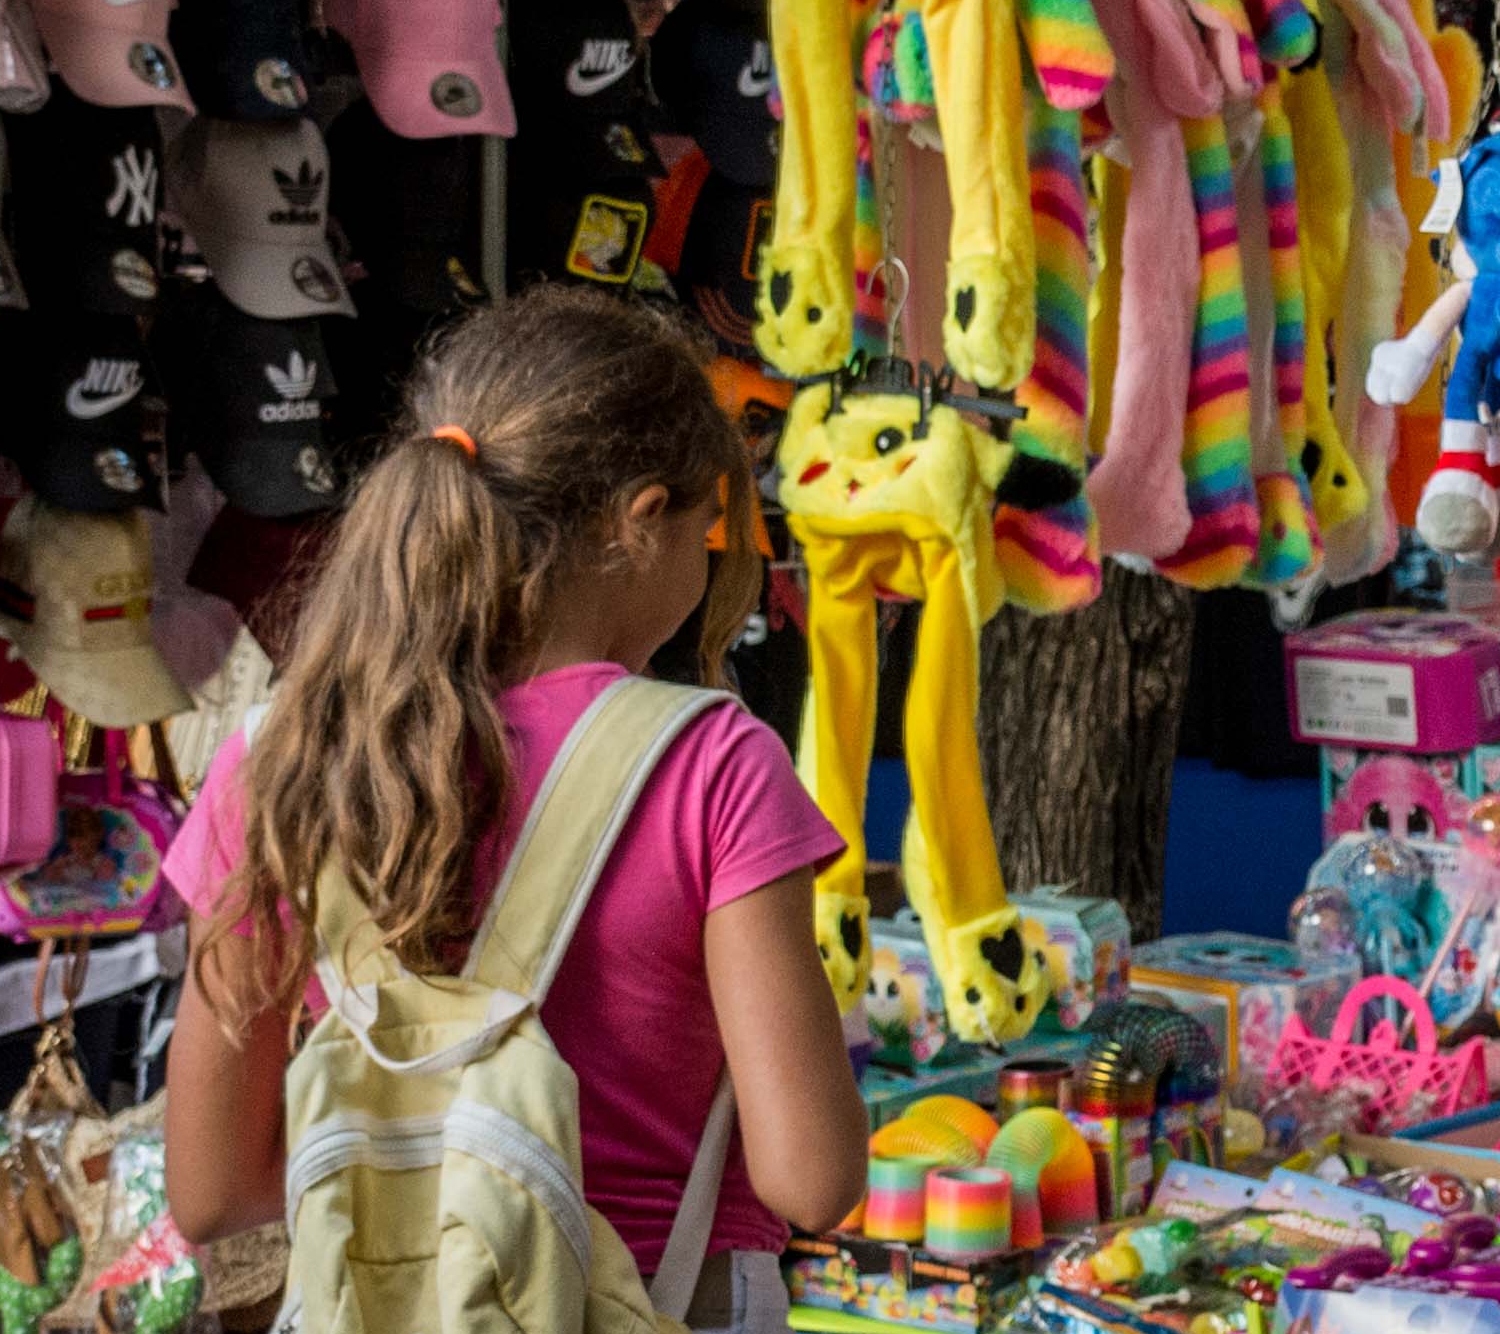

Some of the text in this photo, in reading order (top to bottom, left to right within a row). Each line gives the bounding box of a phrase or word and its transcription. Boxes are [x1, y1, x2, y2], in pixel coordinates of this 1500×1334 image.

[579, 39, 634, 71] NIKE
[106, 145, 158, 226] NY
[268, 208, 322, 226] adidas
[82, 357, 143, 393] NIKE
[258, 398, 322, 424] adidas
